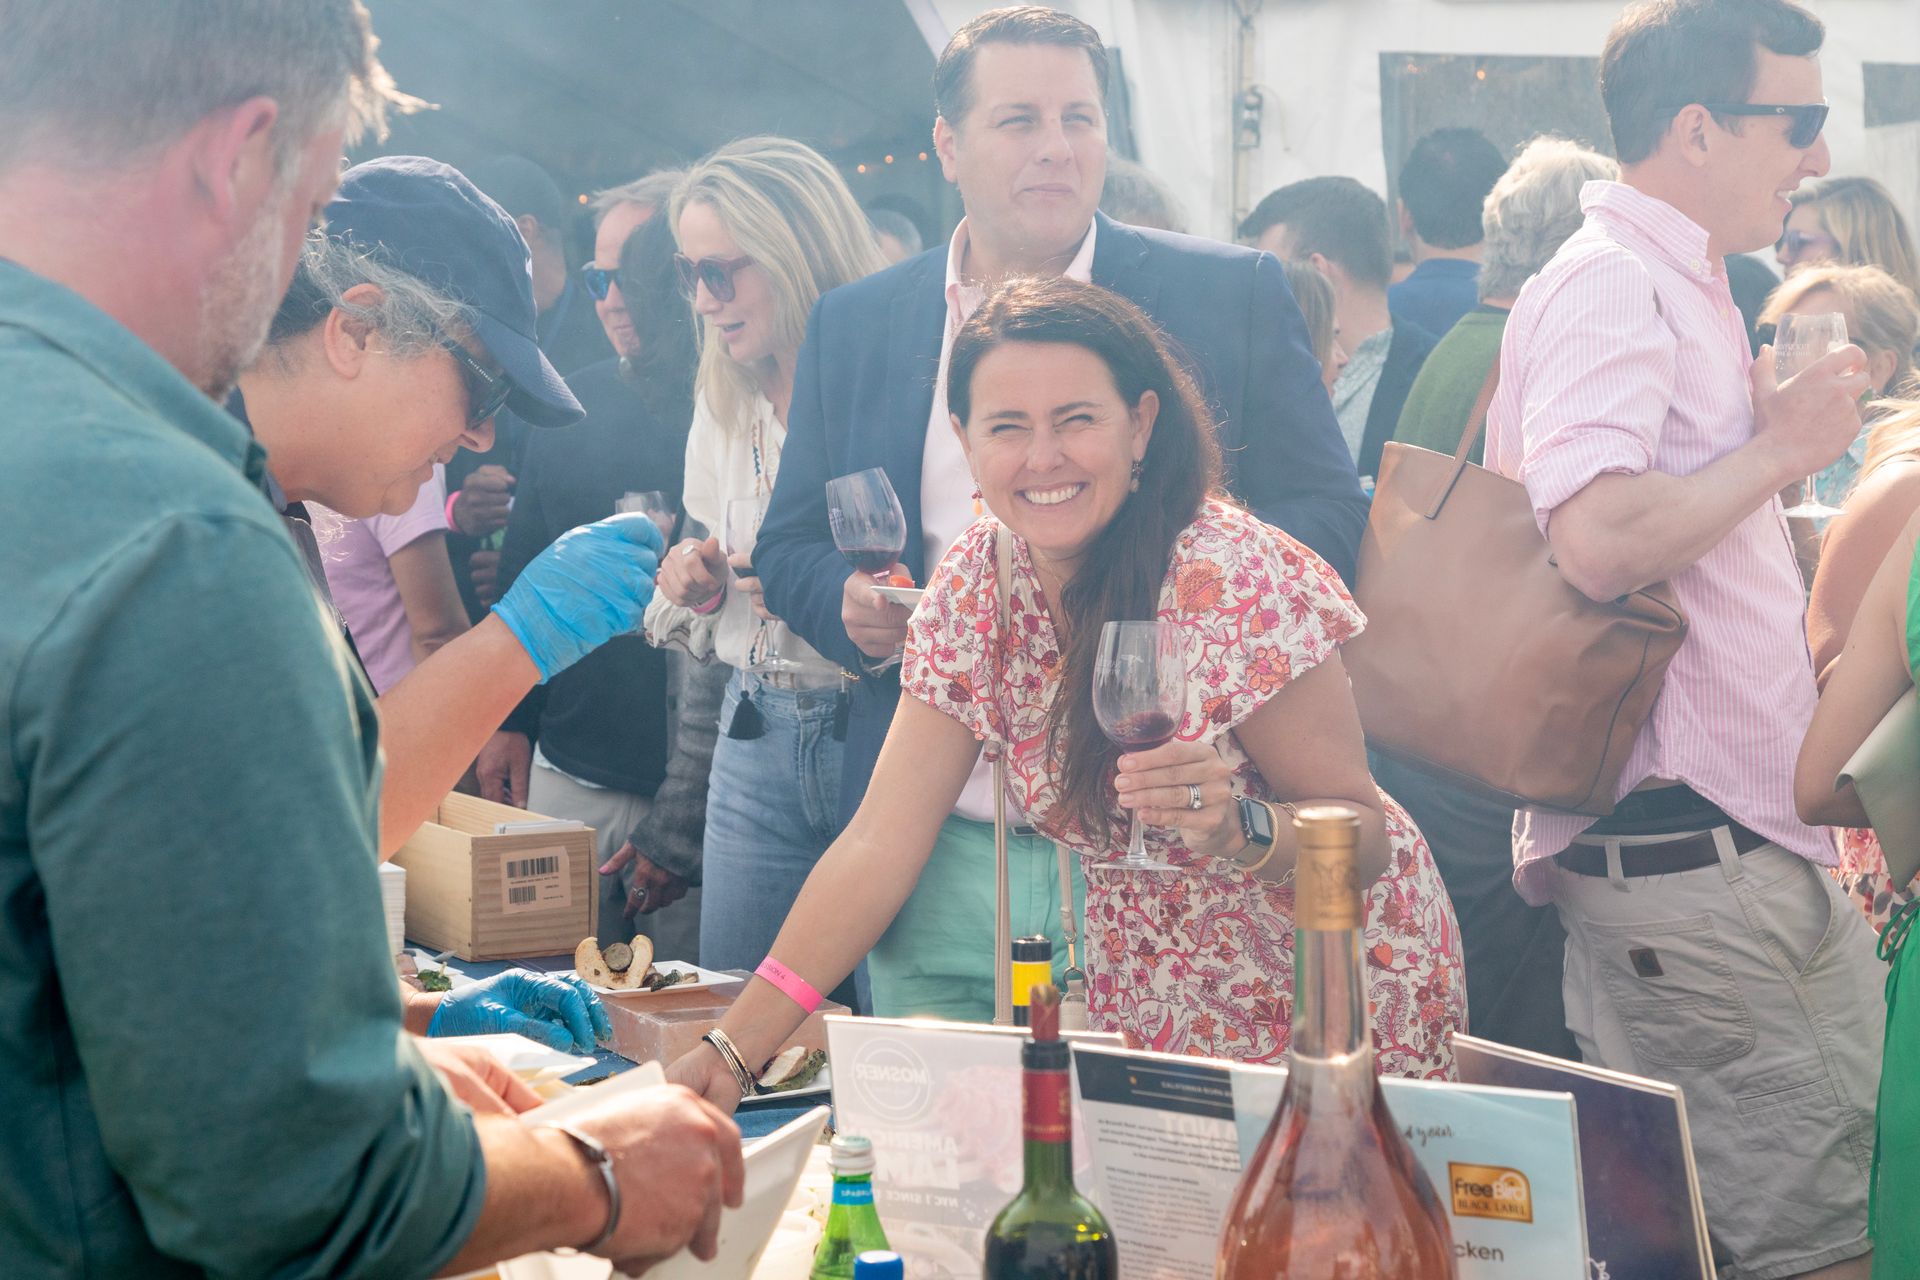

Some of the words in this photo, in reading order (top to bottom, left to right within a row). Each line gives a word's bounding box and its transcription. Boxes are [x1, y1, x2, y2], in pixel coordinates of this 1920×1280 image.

[1458, 1199, 1490, 1212] BLACK
[1494, 1202, 1527, 1216] LABEL
[1454, 1240, 1505, 1263] cken
